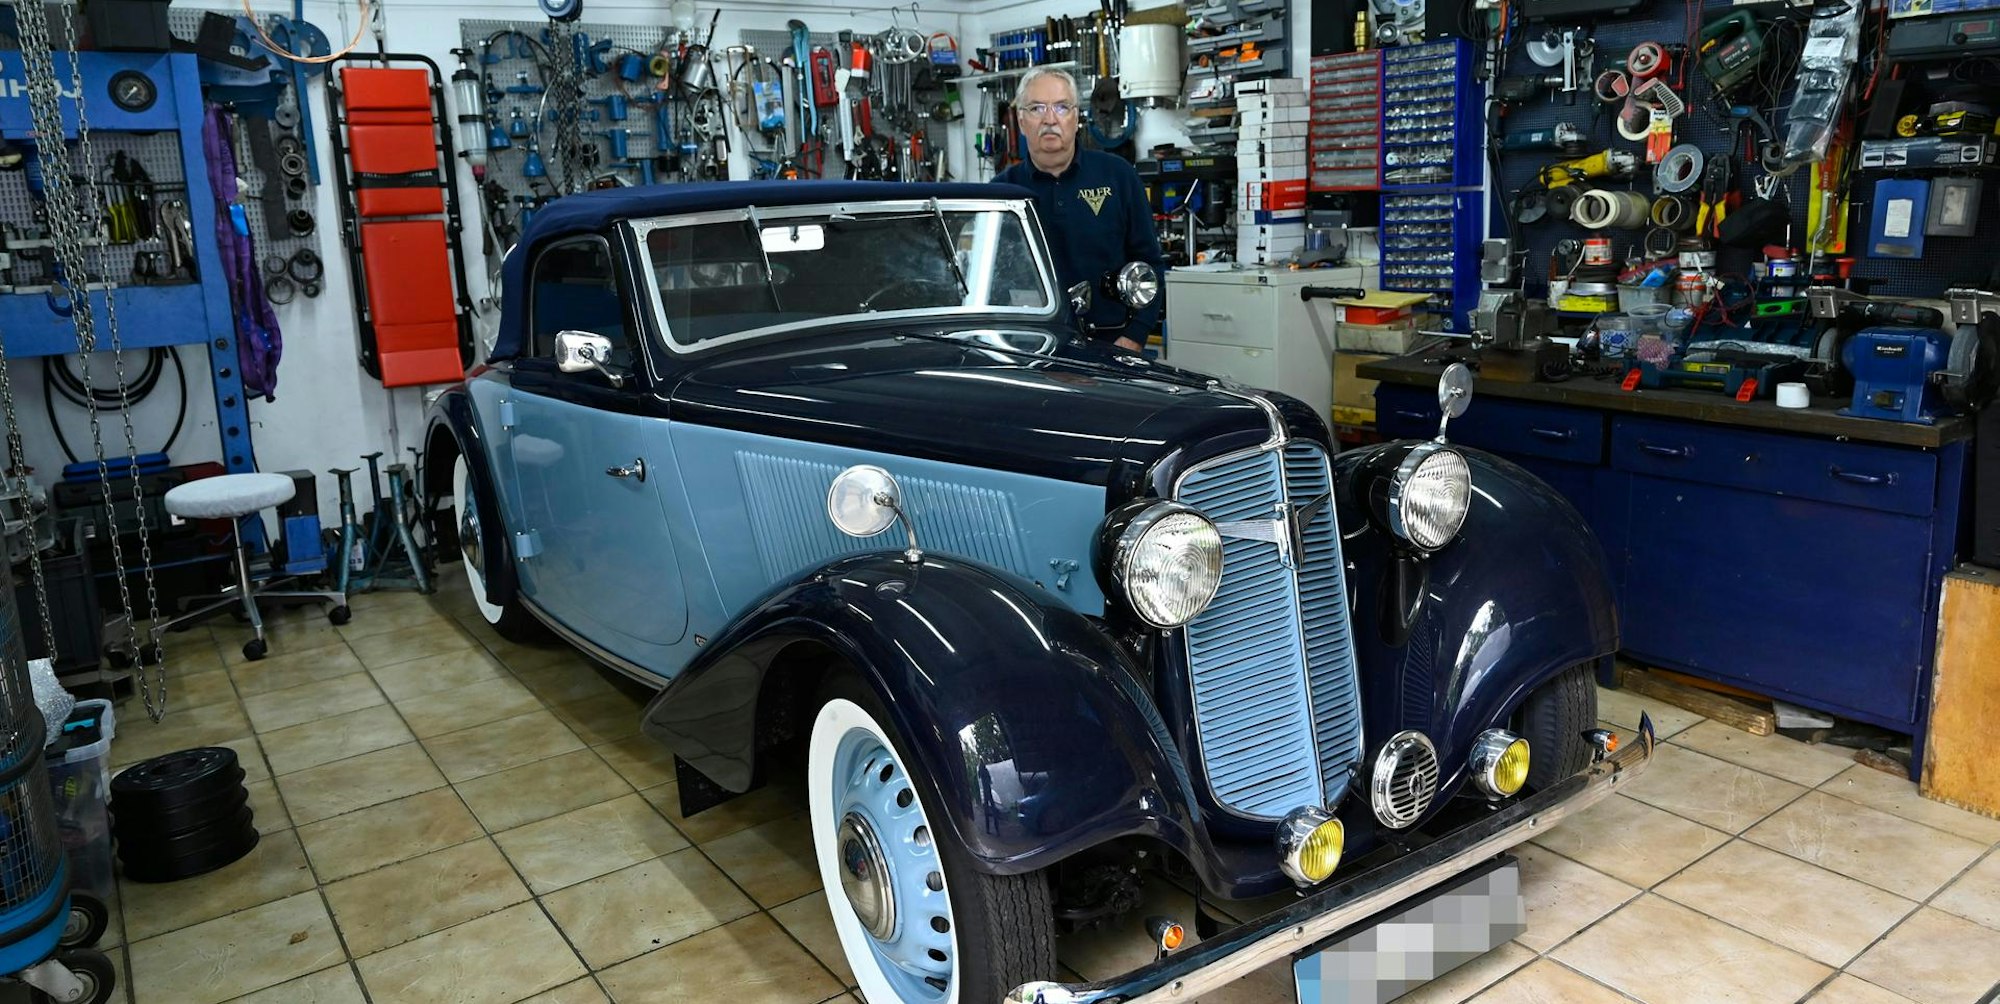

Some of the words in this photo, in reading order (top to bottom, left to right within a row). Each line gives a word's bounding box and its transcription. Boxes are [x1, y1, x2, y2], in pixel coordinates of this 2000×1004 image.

[1414, 1, 1421, 10] 5
[1401, 7, 1408, 15] 6
[1077, 186, 1112, 199] ADLER
